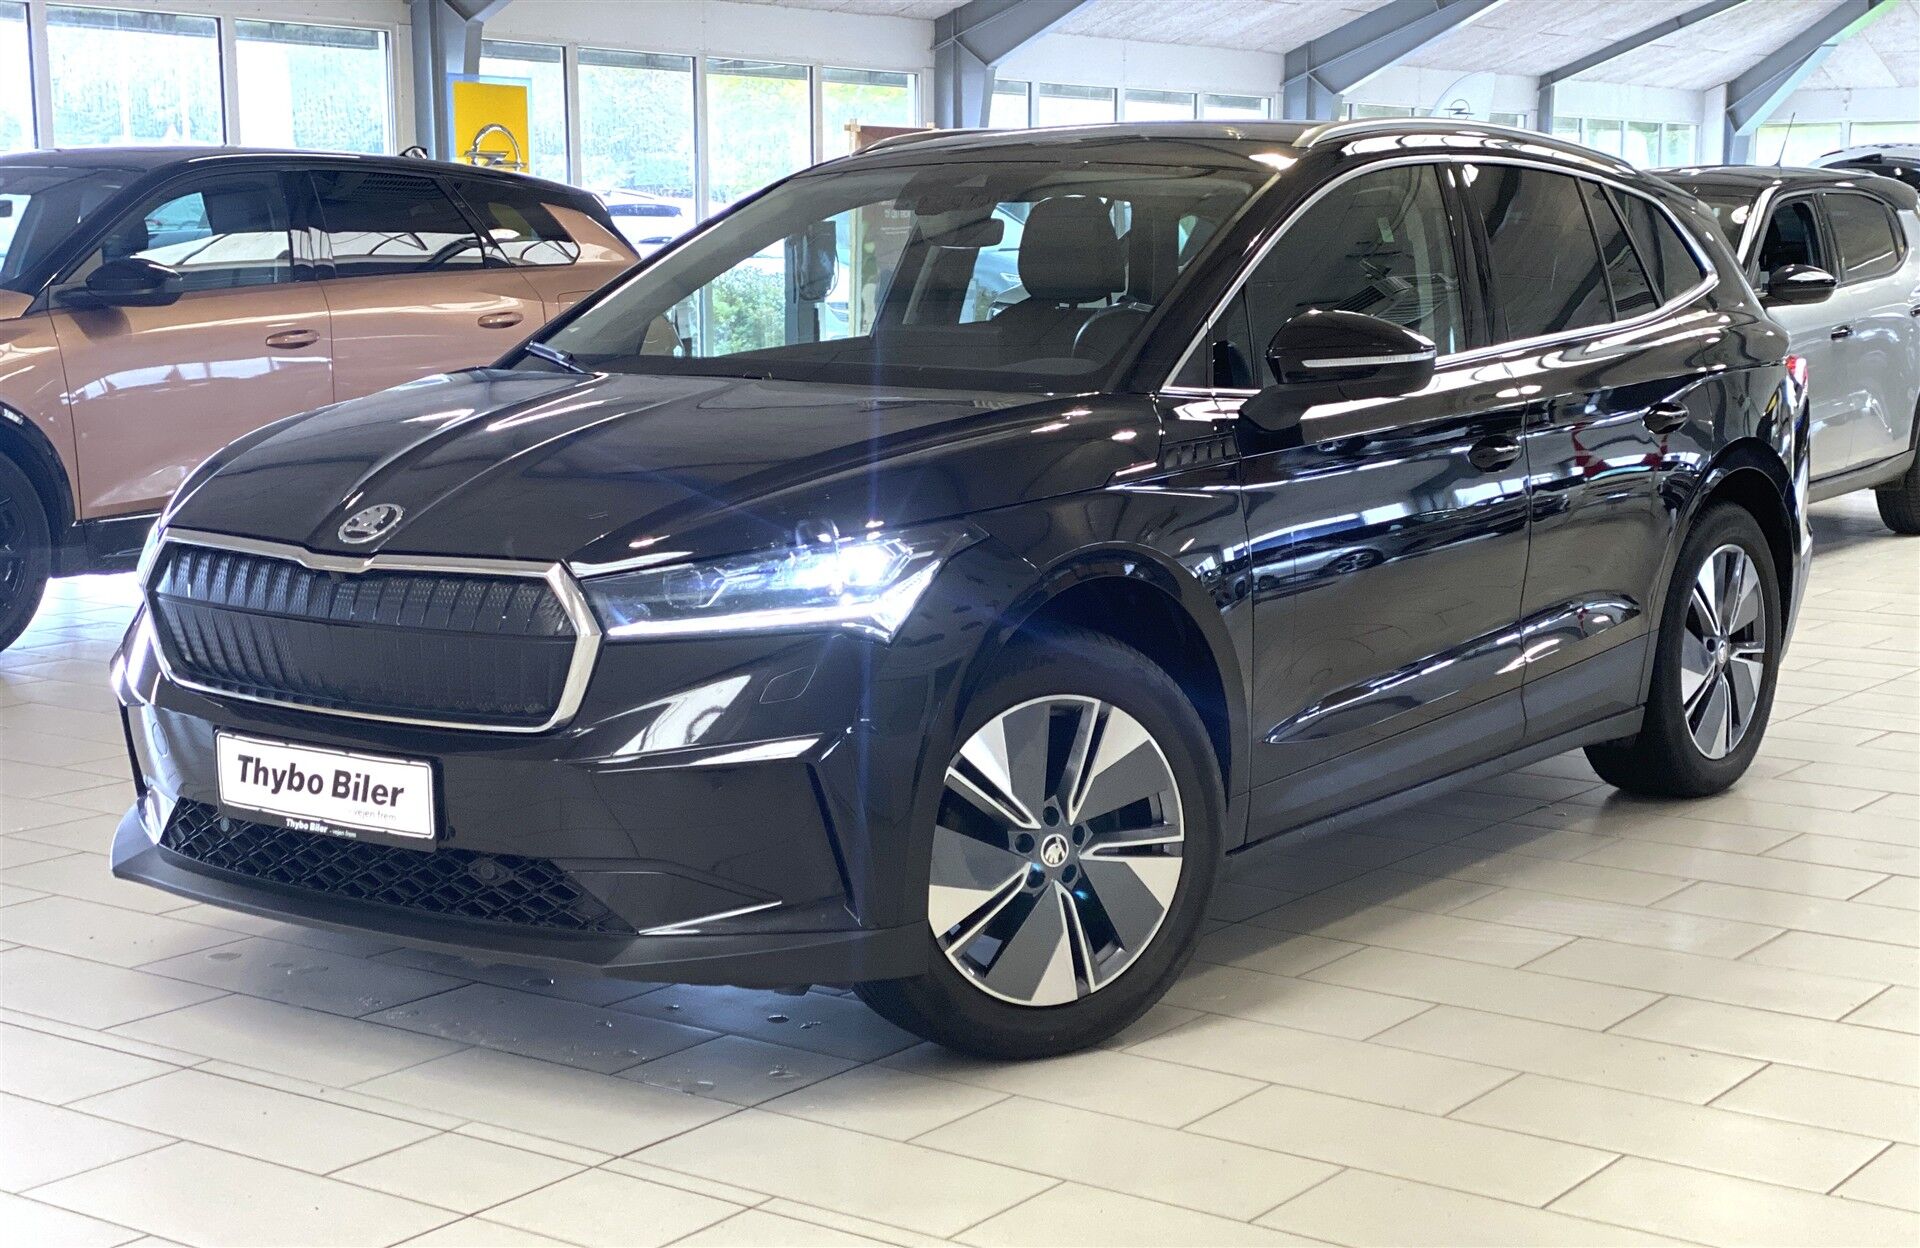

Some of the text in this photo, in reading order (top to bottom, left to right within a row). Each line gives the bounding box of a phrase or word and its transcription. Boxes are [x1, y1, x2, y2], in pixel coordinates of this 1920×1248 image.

[237, 754, 404, 807] Thybo Biler
[286, 818, 309, 830] Thybo
[310, 822, 328, 833] Biler
